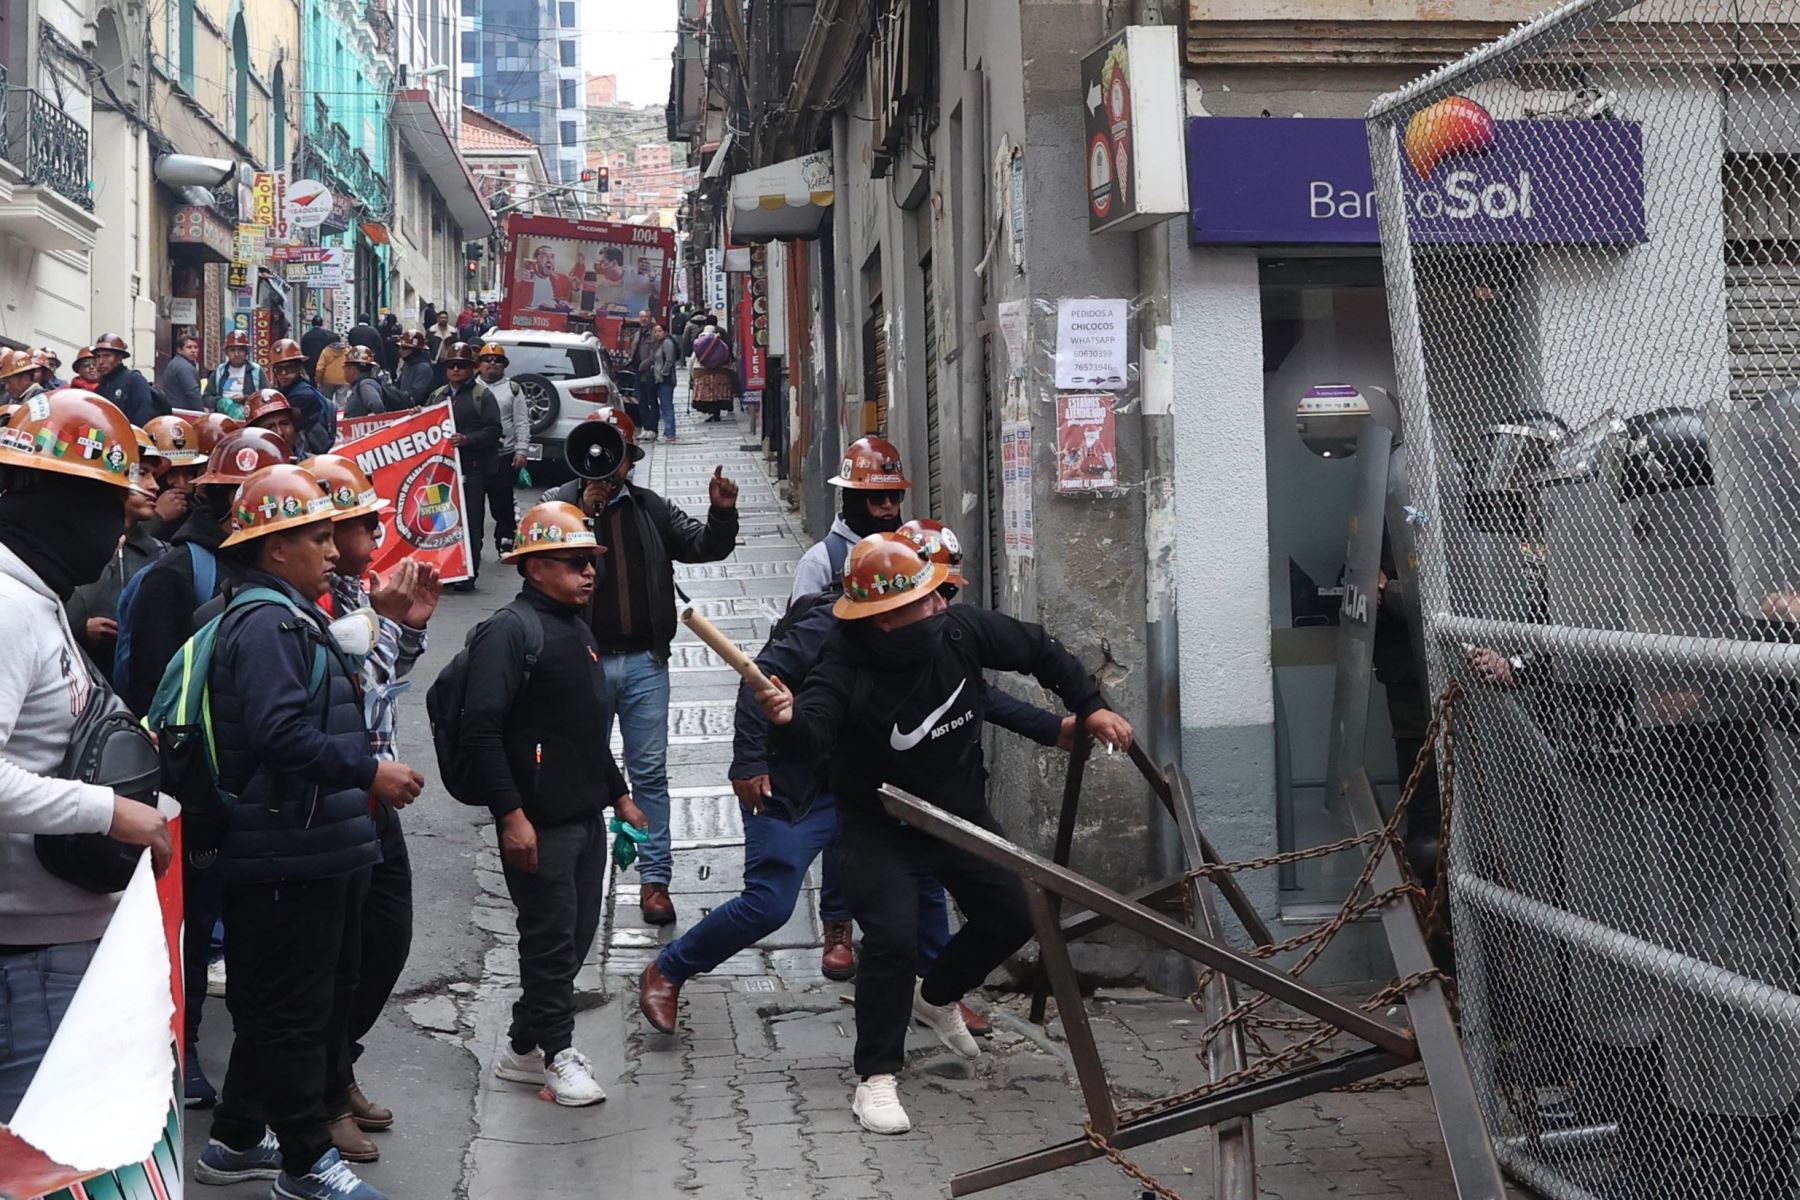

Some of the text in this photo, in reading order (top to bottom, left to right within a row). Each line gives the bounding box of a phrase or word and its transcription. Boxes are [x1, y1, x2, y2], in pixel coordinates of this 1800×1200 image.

[631, 226, 659, 244] 1004
[287, 264, 321, 276] BRASIL
[1071, 310, 1114, 318] PEDIDOS A
[1071, 322, 1114, 331] CHICOCOS
[1070, 336, 1117, 345] WHATSAPP
[355, 418, 456, 475] MINEROS
[930, 723, 950, 741] JUST
[950, 716, 965, 731] DO
